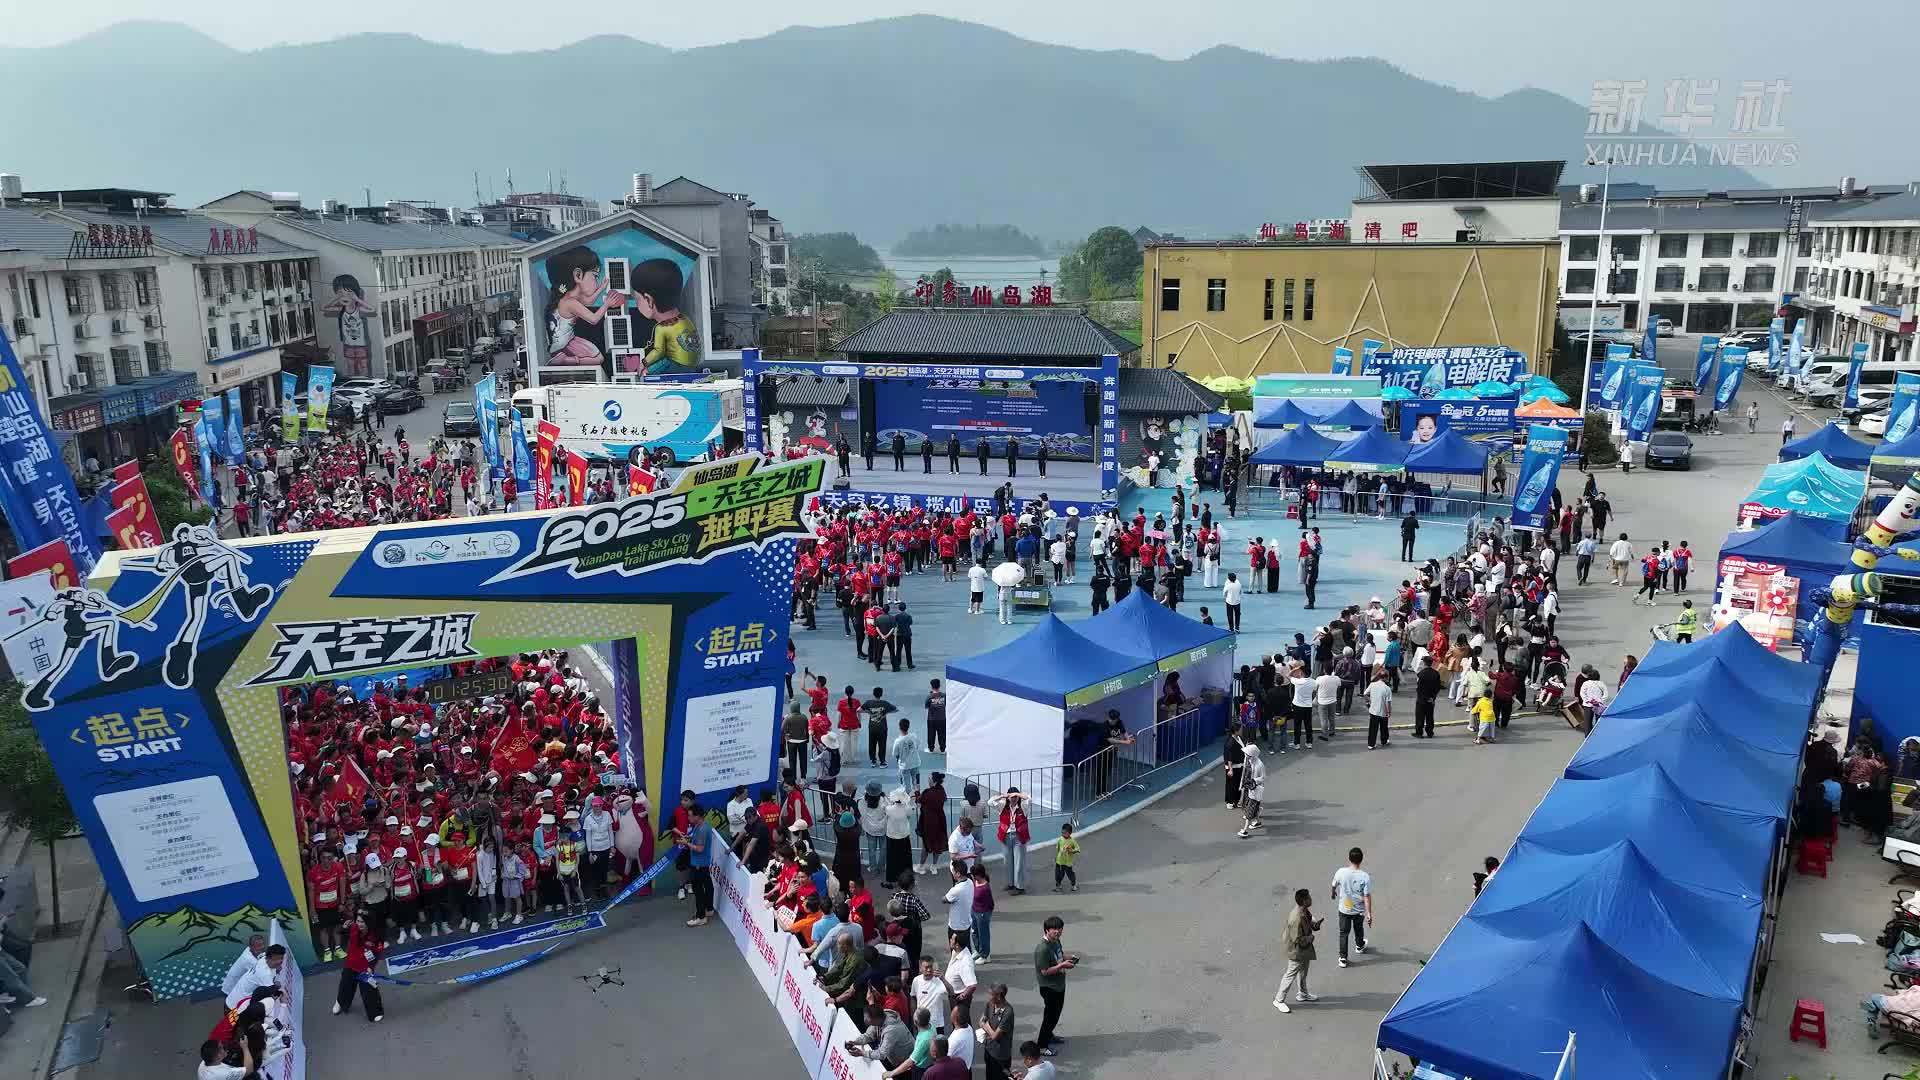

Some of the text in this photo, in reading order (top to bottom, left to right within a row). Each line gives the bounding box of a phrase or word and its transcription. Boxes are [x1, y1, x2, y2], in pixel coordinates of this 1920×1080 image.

[1260, 221, 1418, 241] 仙岛湖清吧
[1391, 347, 1449, 360] 补充电解质
[864, 366, 908, 377] 2025
[1447, 361, 1513, 385] 电解质
[1103, 376, 1116, 471] 奔跑阳新加速度
[694, 463, 738, 485] 仙岛湖
[546, 495, 687, 555] 2025
[697, 496, 798, 553] 越野赛
[578, 533, 692, 568] XianDao Lake Sky City
[623, 544, 689, 567] Trail Running
[29, 636, 52, 672] 中国
[264, 615, 471, 679] 天空之城
[708, 623, 765, 655] 起点
[703, 650, 764, 670] START
[86, 707, 176, 746] 起点
[97, 736, 183, 762] START
[784, 969, 824, 1049] 阳新县人民政府
